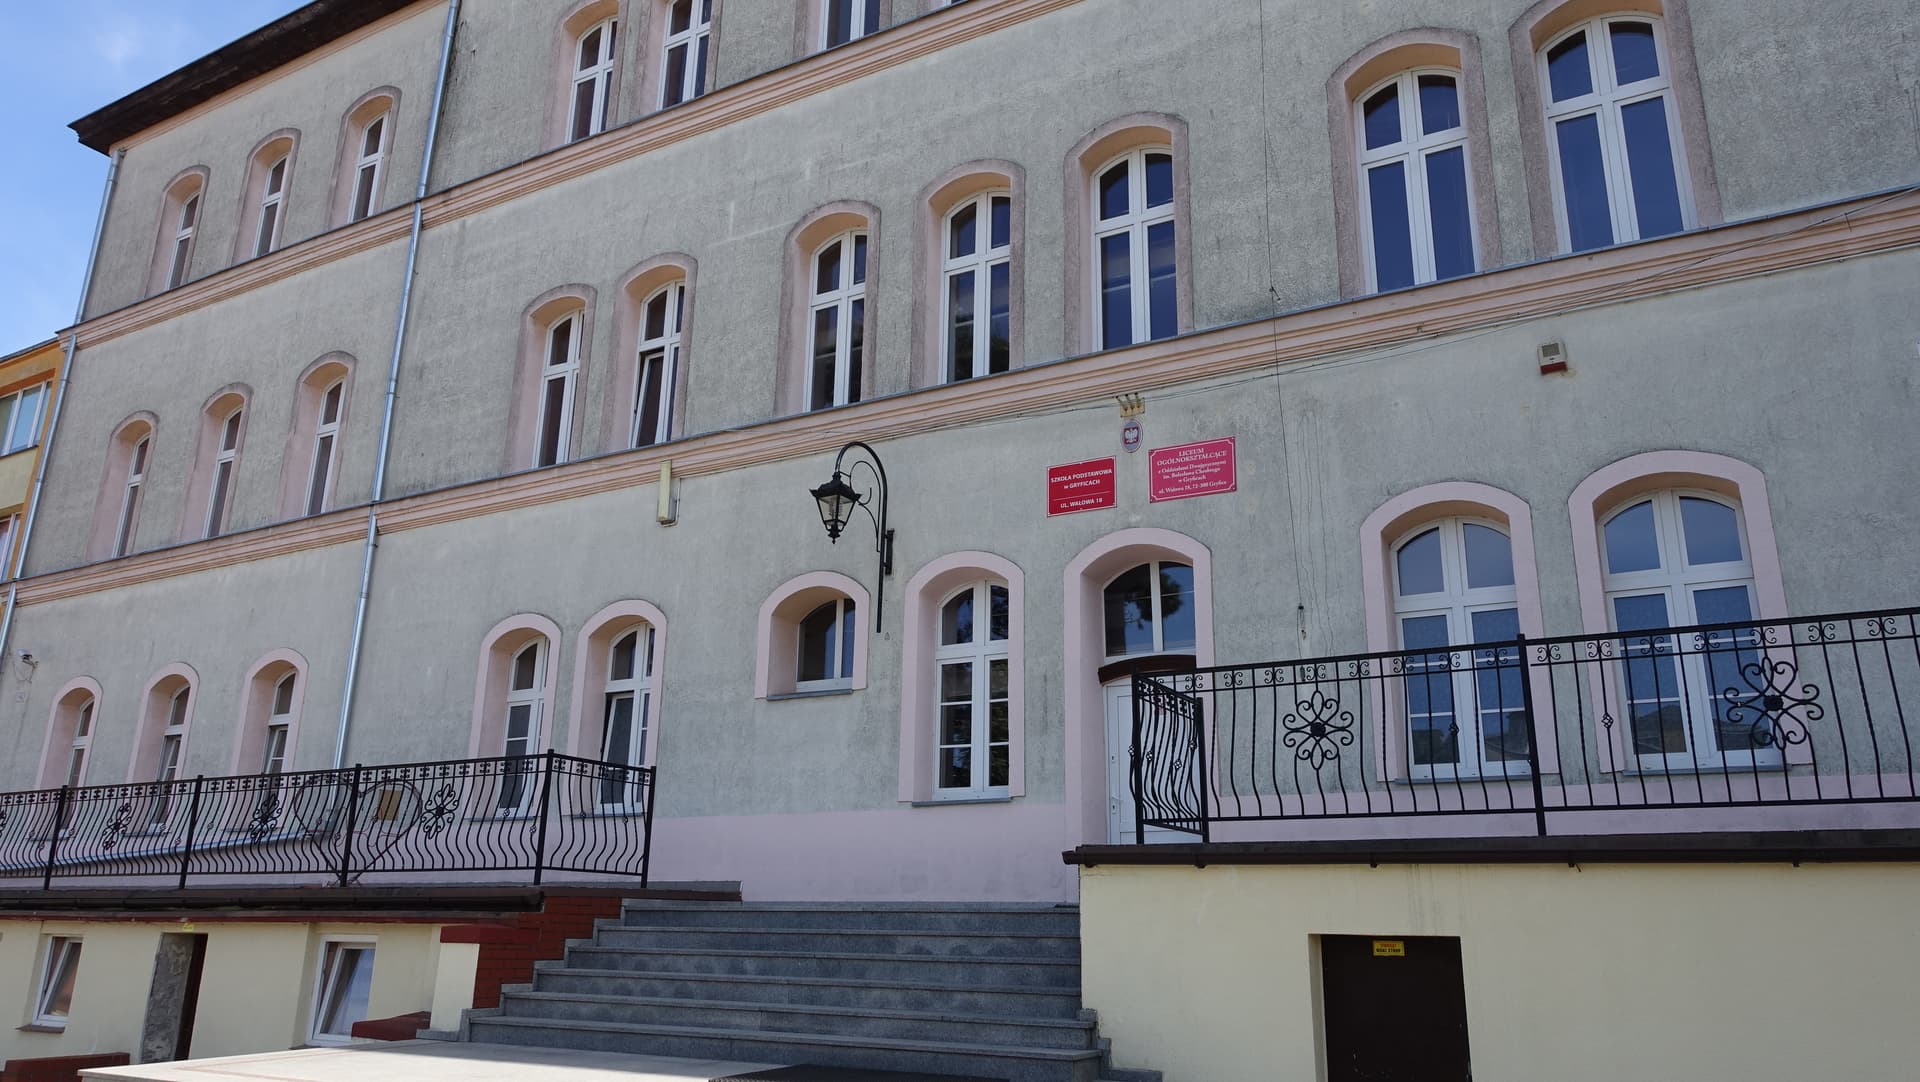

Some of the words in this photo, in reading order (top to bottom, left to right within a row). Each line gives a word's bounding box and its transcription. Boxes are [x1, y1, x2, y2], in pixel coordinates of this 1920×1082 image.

[1179, 447, 1204, 457] LICEUM
[1051, 475, 1072, 483] SZKOŁA
[1072, 469, 1113, 480] PODSTAWOWA
[1069, 479, 1101, 489] GRYFICACH
[1070, 498, 1095, 507] WAŁOWA
